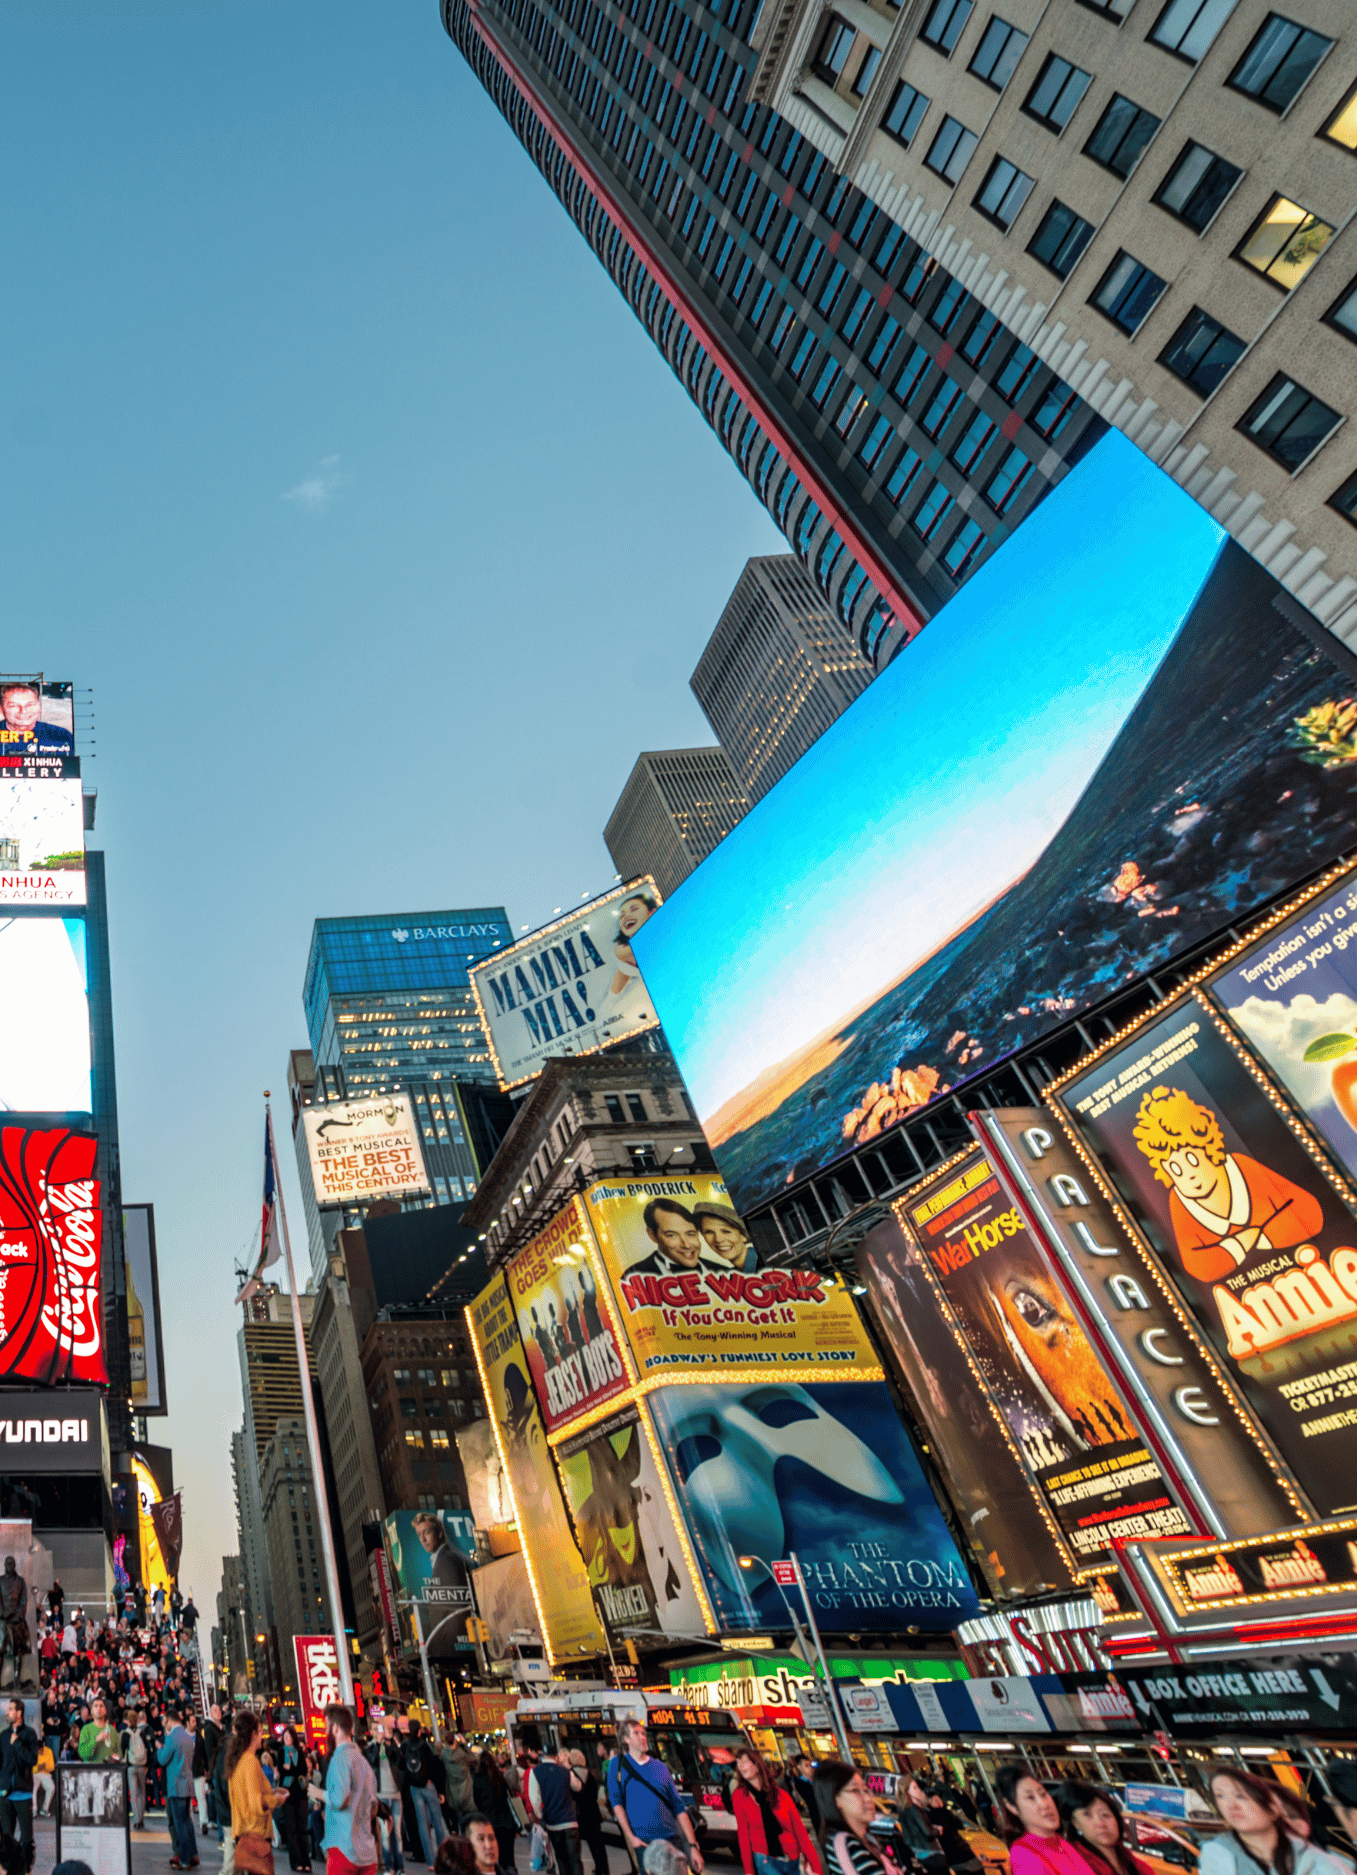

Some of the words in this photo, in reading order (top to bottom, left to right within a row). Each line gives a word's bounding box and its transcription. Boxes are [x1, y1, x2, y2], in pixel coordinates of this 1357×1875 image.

[23, 757, 63, 767] XINHUA
[12, 889, 74, 900] AGENCY
[413, 923, 500, 941] BARCLAYS
[1239, 931, 1307, 985] Temptation
[1304, 910, 1334, 941] isn't
[1333, 906, 1347, 920] a
[487, 930, 606, 1018] MAMMA
[1264, 959, 1307, 992] Unless
[1304, 943, 1333, 970] you
[521, 979, 597, 1049] MIA!
[1090, 1099, 1114, 1119] BEST
[1111, 1072, 1153, 1105] MUSICAL
[1150, 1038, 1199, 1080] RETURNS!
[1076, 1095, 1094, 1115] THE
[1091, 1079, 1119, 1104] TONY
[318, 1146, 349, 1158] BEST
[353, 1137, 412, 1153] MUSICAL
[363, 1147, 413, 1168] BEST
[322, 1165, 392, 1184] MUSICAL
[394, 1161, 417, 1174] OF
[324, 1181, 354, 1194] THIS
[627, 1180, 697, 1198] BRODERICK
[511, 1248, 533, 1278] THE
[534, 1205, 579, 1258] CROWD
[516, 1259, 549, 1295] GOES
[1020, 1126, 1220, 1426] PALACE
[1226, 1275, 1247, 1292] THE
[1248, 1254, 1294, 1283] MUSICAL
[620, 1271, 712, 1313] NICE
[705, 1268, 829, 1309] WORK
[1213, 1243, 1357, 1361] Annie
[662, 1308, 680, 1327] If
[680, 1308, 712, 1328] You
[712, 1307, 745, 1324] Can
[747, 1308, 779, 1326] Get
[780, 1306, 796, 1324] It
[674, 1331, 692, 1341] The
[760, 1330, 797, 1340] Musical
[721, 1351, 779, 1364] FUNNIEST
[780, 1351, 816, 1363] LOVE
[817, 1350, 857, 1362] STORY
[544, 1350, 590, 1418] JERSEY
[581, 1329, 623, 1393] BOYS
[1290, 1396, 1310, 1413] OR
[1069, 1524, 1111, 1548] LINCOLN
[1108, 1515, 1150, 1538] CENTER
[847, 1542, 889, 1560] THE
[423, 1577, 441, 1586] THE
[797, 1560, 968, 1590] PHANTOM
[1185, 1563, 1244, 1600] Annie
[1258, 1549, 1328, 1590] Annie
[815, 1592, 844, 1610] OF
[849, 1592, 889, 1609] THE
[892, 1591, 962, 1609] OPERA
[717, 1671, 755, 1707] sbarro
[1144, 1677, 1187, 1700] BOX
[1187, 1672, 1253, 1697] OFFICE
[1255, 1668, 1309, 1694] HERE
